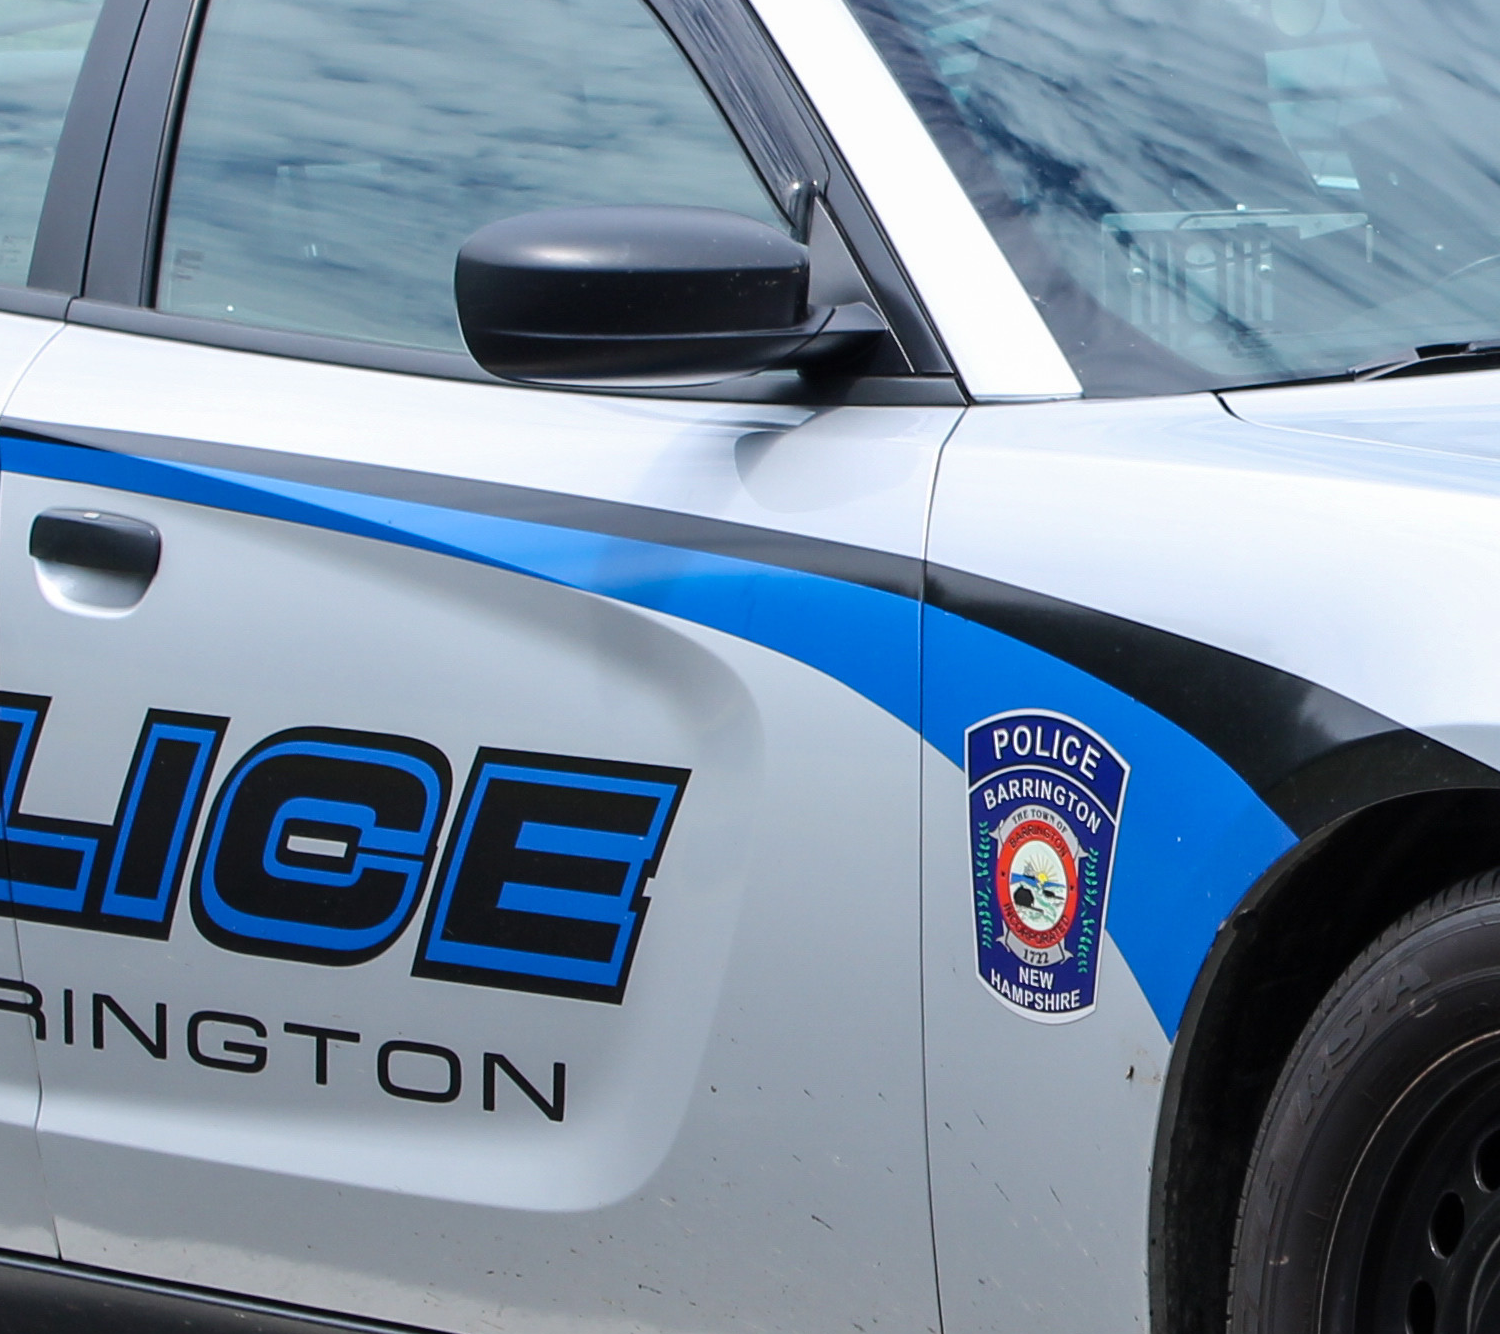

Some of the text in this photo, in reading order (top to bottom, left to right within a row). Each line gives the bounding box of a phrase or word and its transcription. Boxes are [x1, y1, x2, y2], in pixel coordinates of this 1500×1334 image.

[993, 725, 1101, 780] POLICE
[983, 777, 1102, 834] BARRINGTON
[1012, 808, 1069, 834] THE TOWN OF
[1009, 824, 1067, 858] BARRINGTON
[1003, 903, 1071, 945] INCORPORATED
[1023, 948, 1050, 965] 1722
[991, 968, 1081, 1011] HAMPSHIRE
[1019, 966, 1054, 991] NEW
